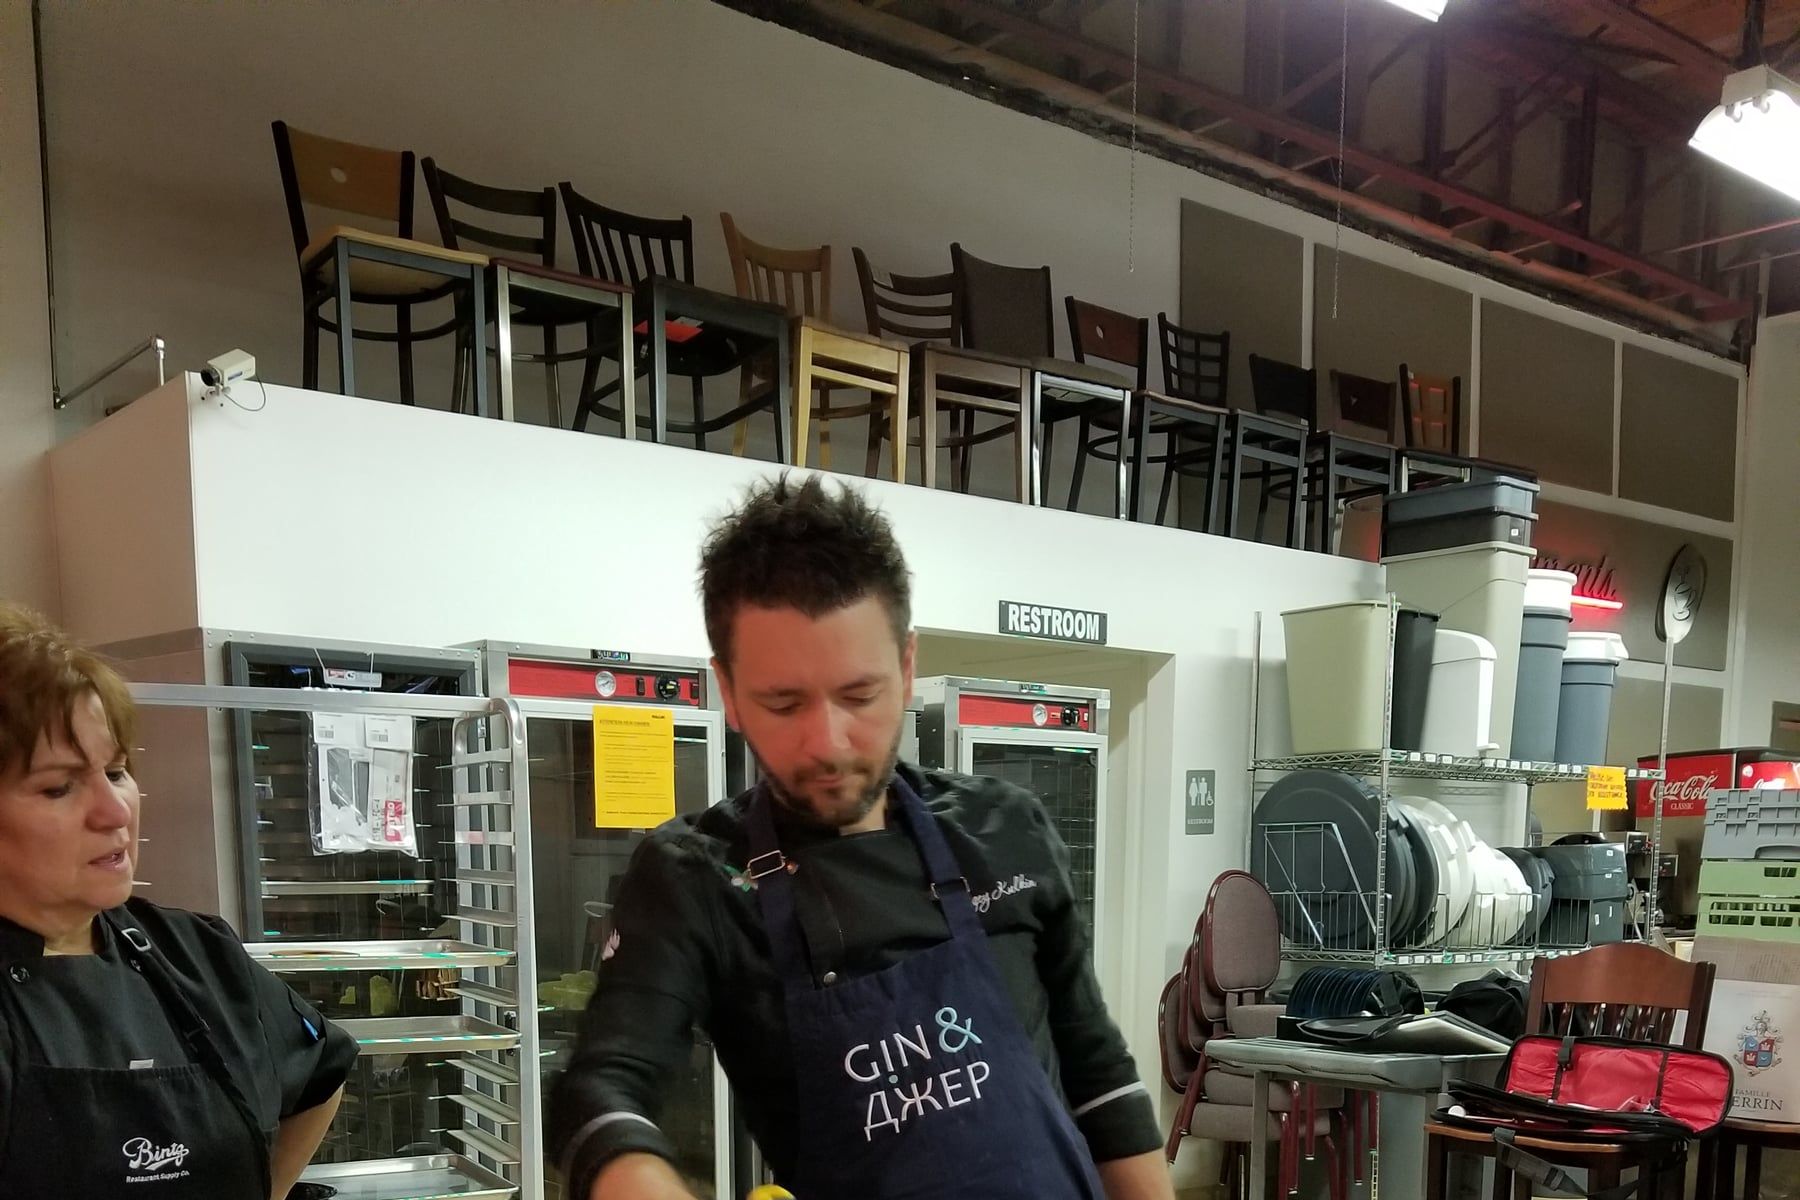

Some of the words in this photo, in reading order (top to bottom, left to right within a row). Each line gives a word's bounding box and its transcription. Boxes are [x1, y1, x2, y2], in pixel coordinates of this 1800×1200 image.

[1008, 603, 1100, 640] RESTROOM
[1670, 802, 1694, 810] CLASSIC
[935, 1006, 983, 1053] &
[864, 1061, 990, 1142] ДЖЕР
[1732, 1096, 1783, 1110] ERRIN
